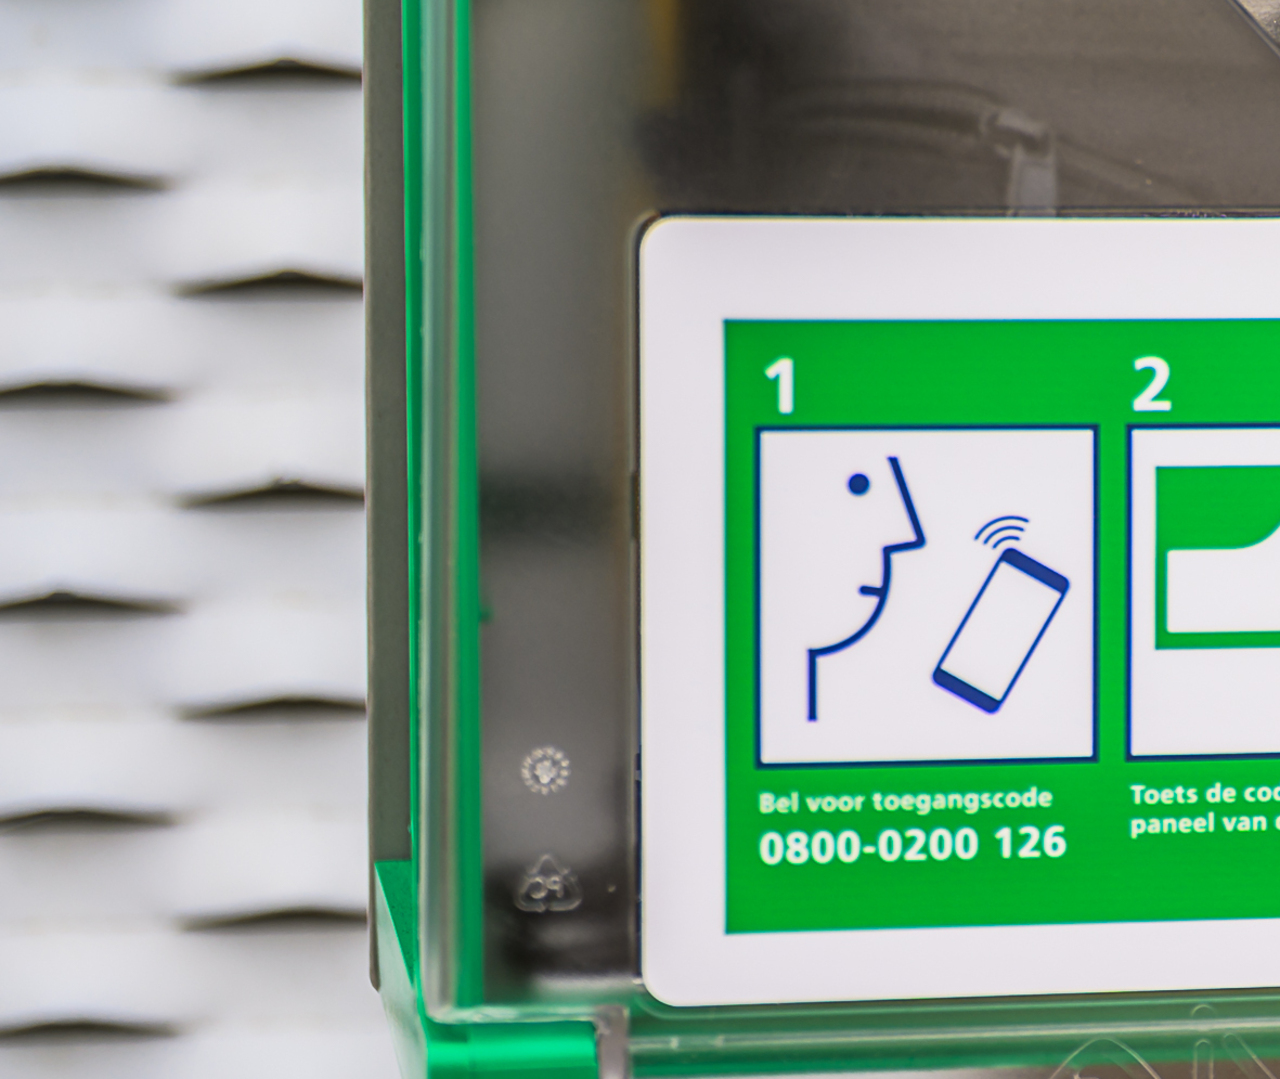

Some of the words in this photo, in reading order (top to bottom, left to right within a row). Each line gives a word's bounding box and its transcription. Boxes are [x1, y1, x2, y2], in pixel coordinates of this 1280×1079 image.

[765, 357, 795, 415] 1
[1132, 356, 1173, 412] 2
[758, 791, 800, 815] Bel
[805, 794, 866, 813] voor
[871, 786, 1054, 816] toegangscode
[1130, 783, 1199, 806] Toets
[1205, 781, 1238, 804] de
[1130, 810, 1216, 839] paneel
[1222, 814, 1268, 833] van
[758, 826, 980, 866] 0800-0200
[994, 824, 1068, 860] 126
